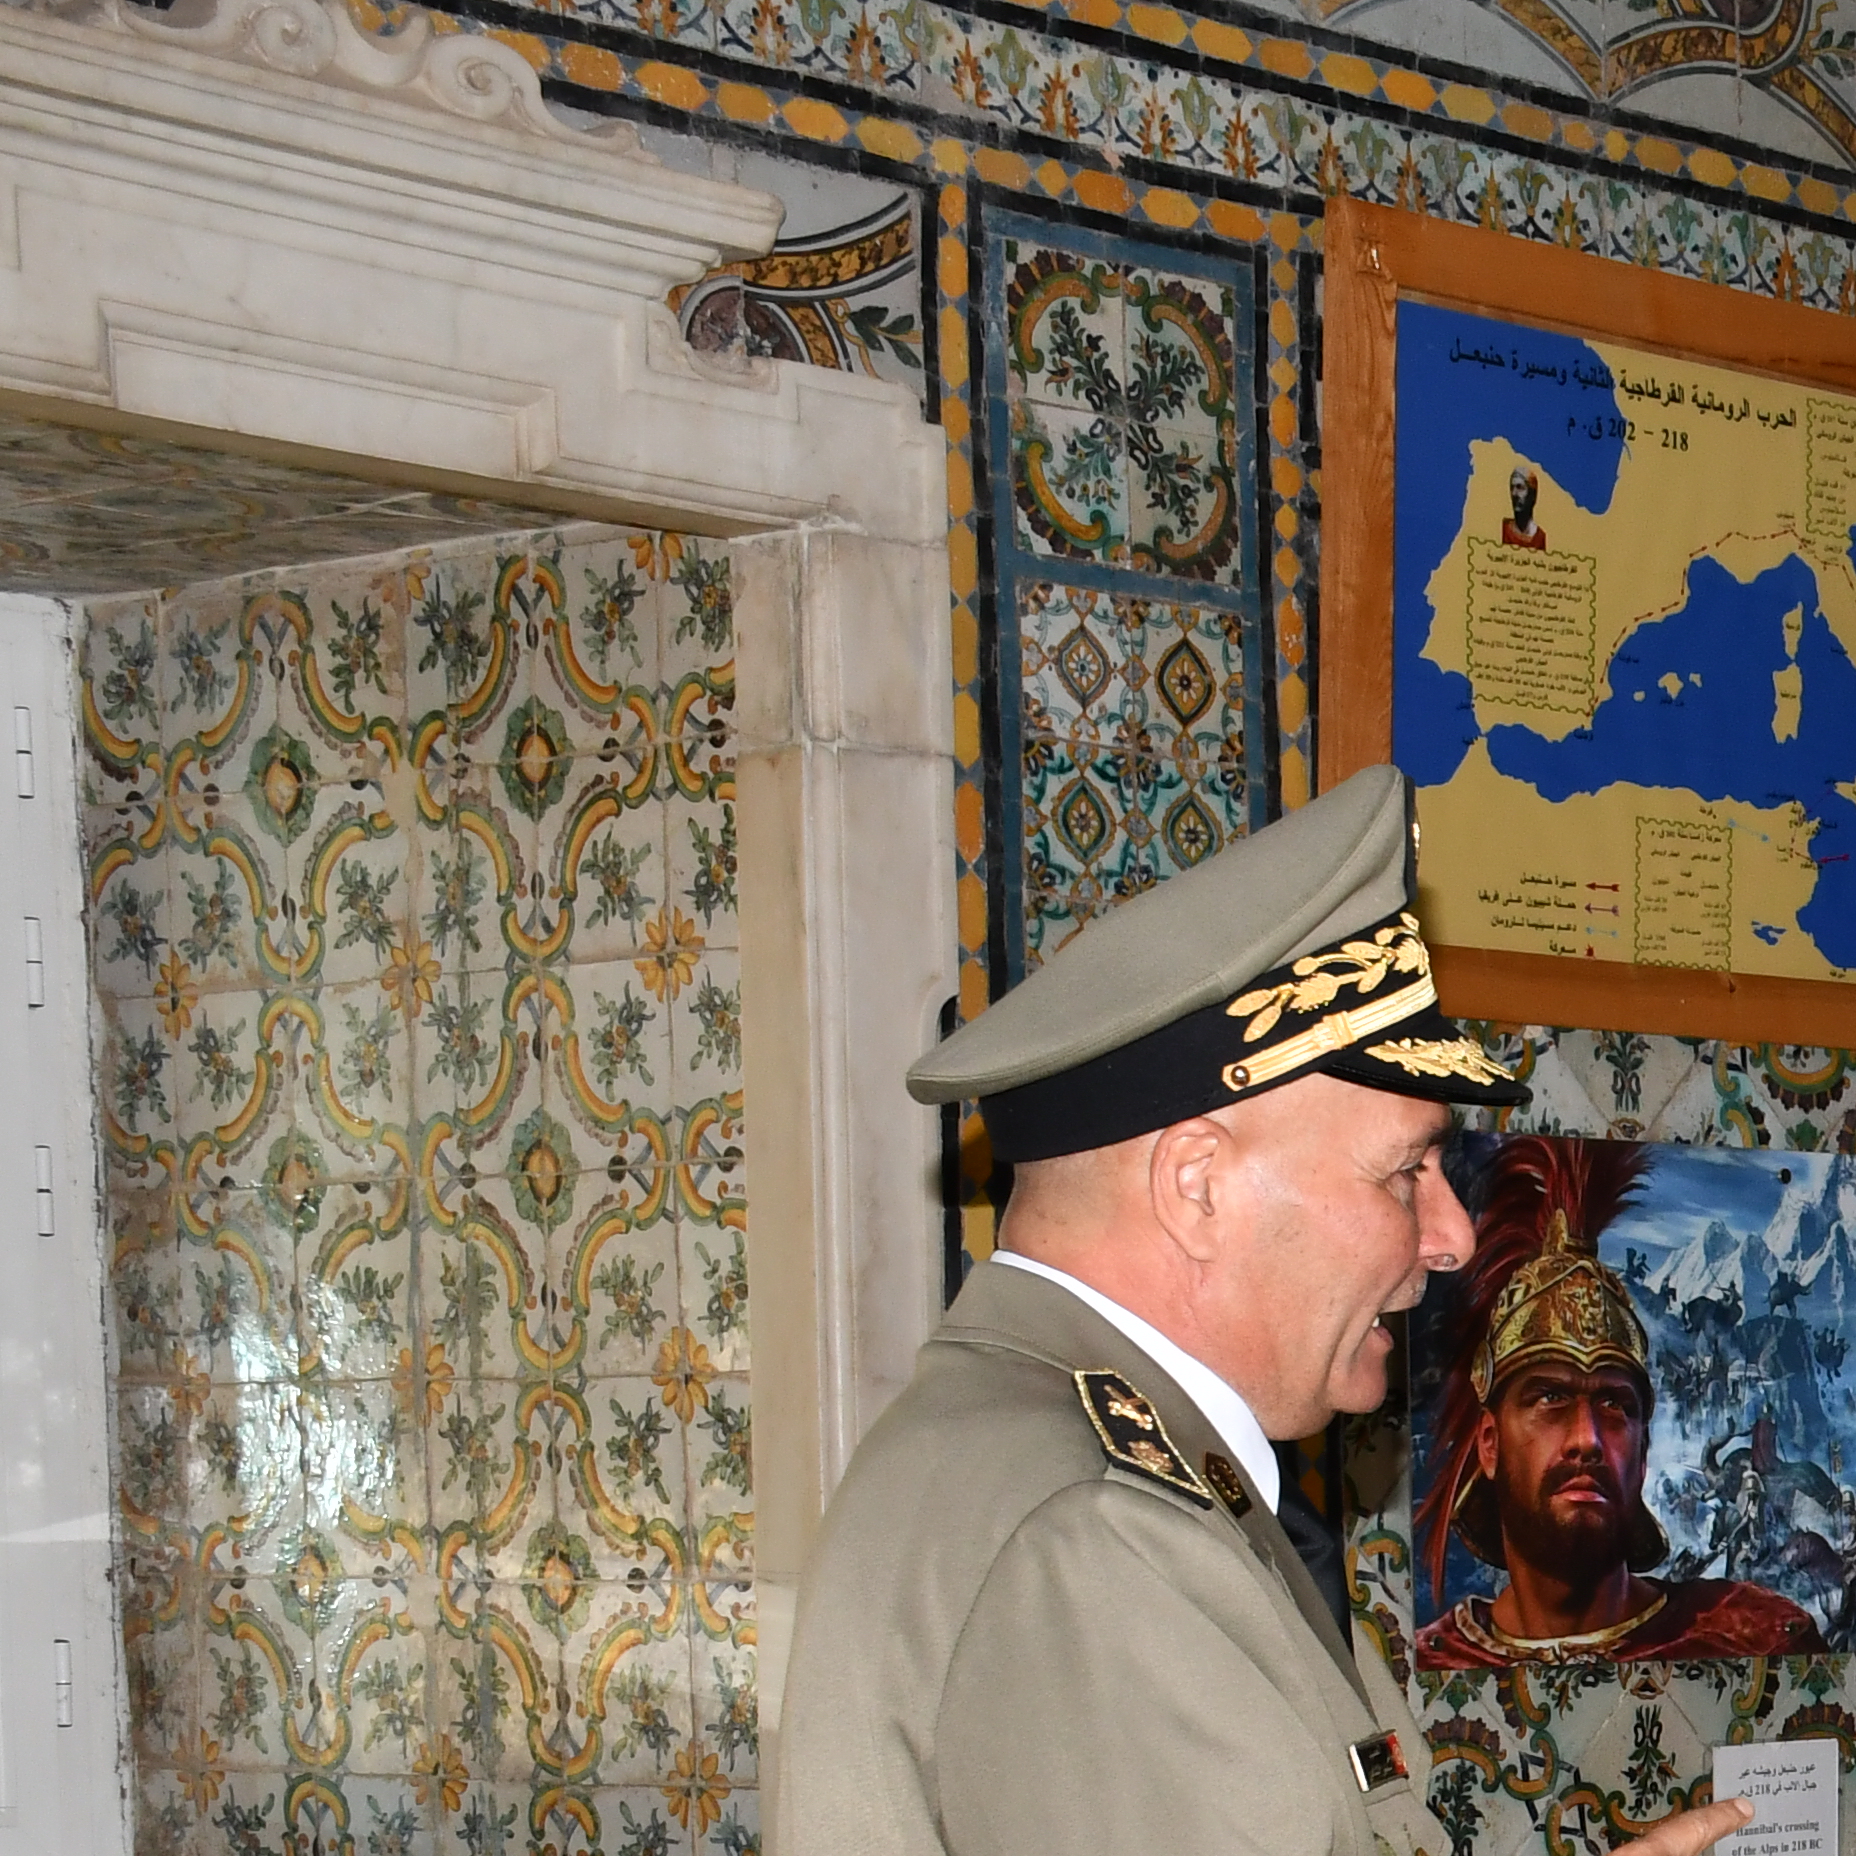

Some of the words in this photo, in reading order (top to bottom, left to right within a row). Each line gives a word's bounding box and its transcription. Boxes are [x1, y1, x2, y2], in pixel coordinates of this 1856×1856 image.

[1572, 359, 1616, 391] الثانية
[1619, 369, 1685, 407] القرطاجية
[1691, 384, 1751, 422] الرومانية
[1608, 417, 1636, 442] 202
[1756, 408, 1796, 431] الحرب
[1661, 428, 1689, 452] 218
[1735, 1822, 1783, 1838] Hannibal's
[1784, 1819, 1820, 1833] crossing
[1731, 1847, 1742, 1856] of
[1743, 1845, 1757, 1856] the
[1760, 1843, 1779, 1856] Alps
[1780, 1842, 1790, 1853] in
[1791, 1840, 1807, 1852] 218
[1809, 1837, 1824, 1850] BC
